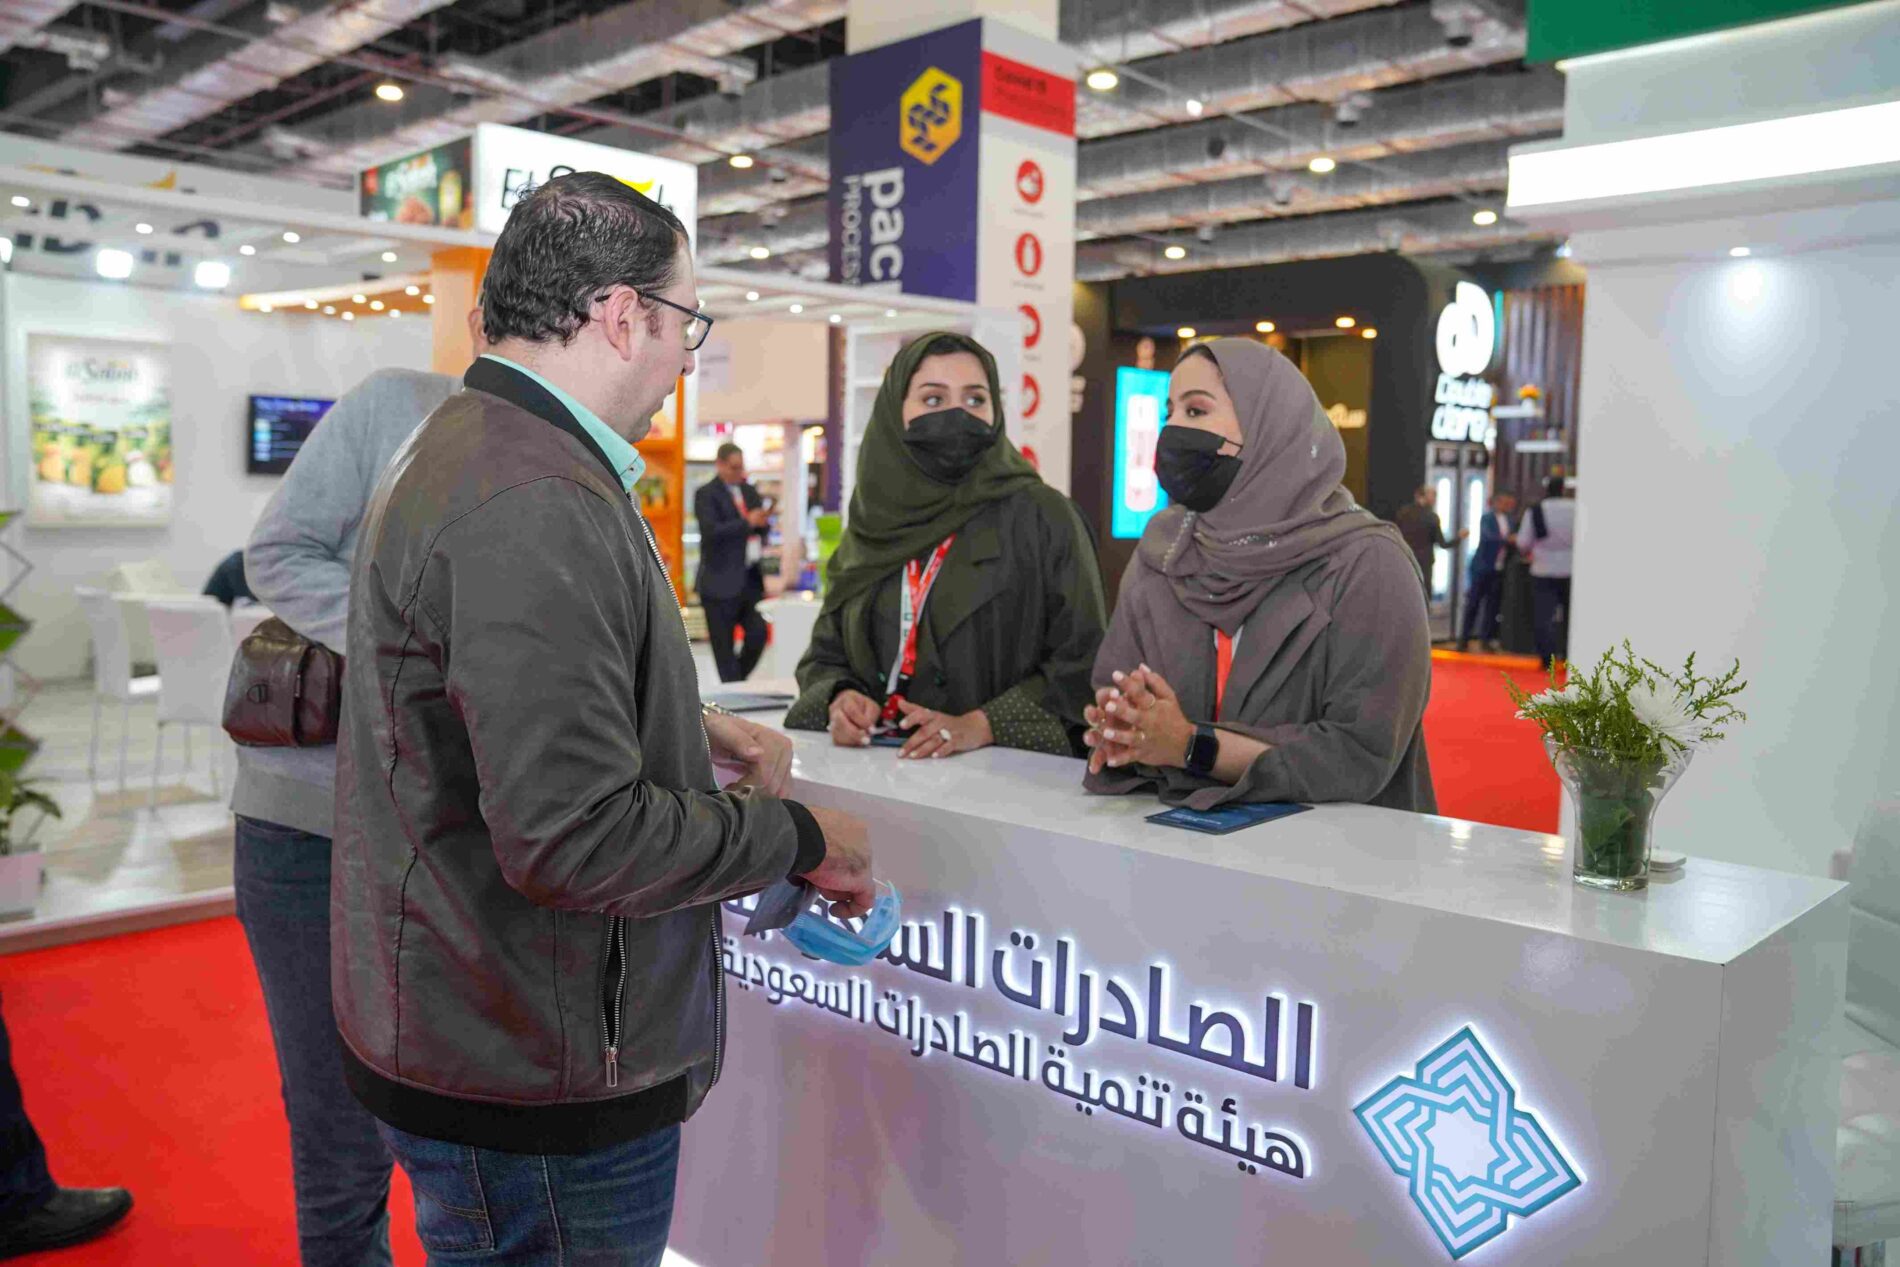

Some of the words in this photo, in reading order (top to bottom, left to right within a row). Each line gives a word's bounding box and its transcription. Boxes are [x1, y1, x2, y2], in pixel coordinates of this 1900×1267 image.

[874, 988, 1037, 1082] الصادرات
[992, 930, 1317, 1090] الصادرات
[1041, 1044, 1171, 1129] تنمية
[1176, 1090, 1312, 1179] هيئة
